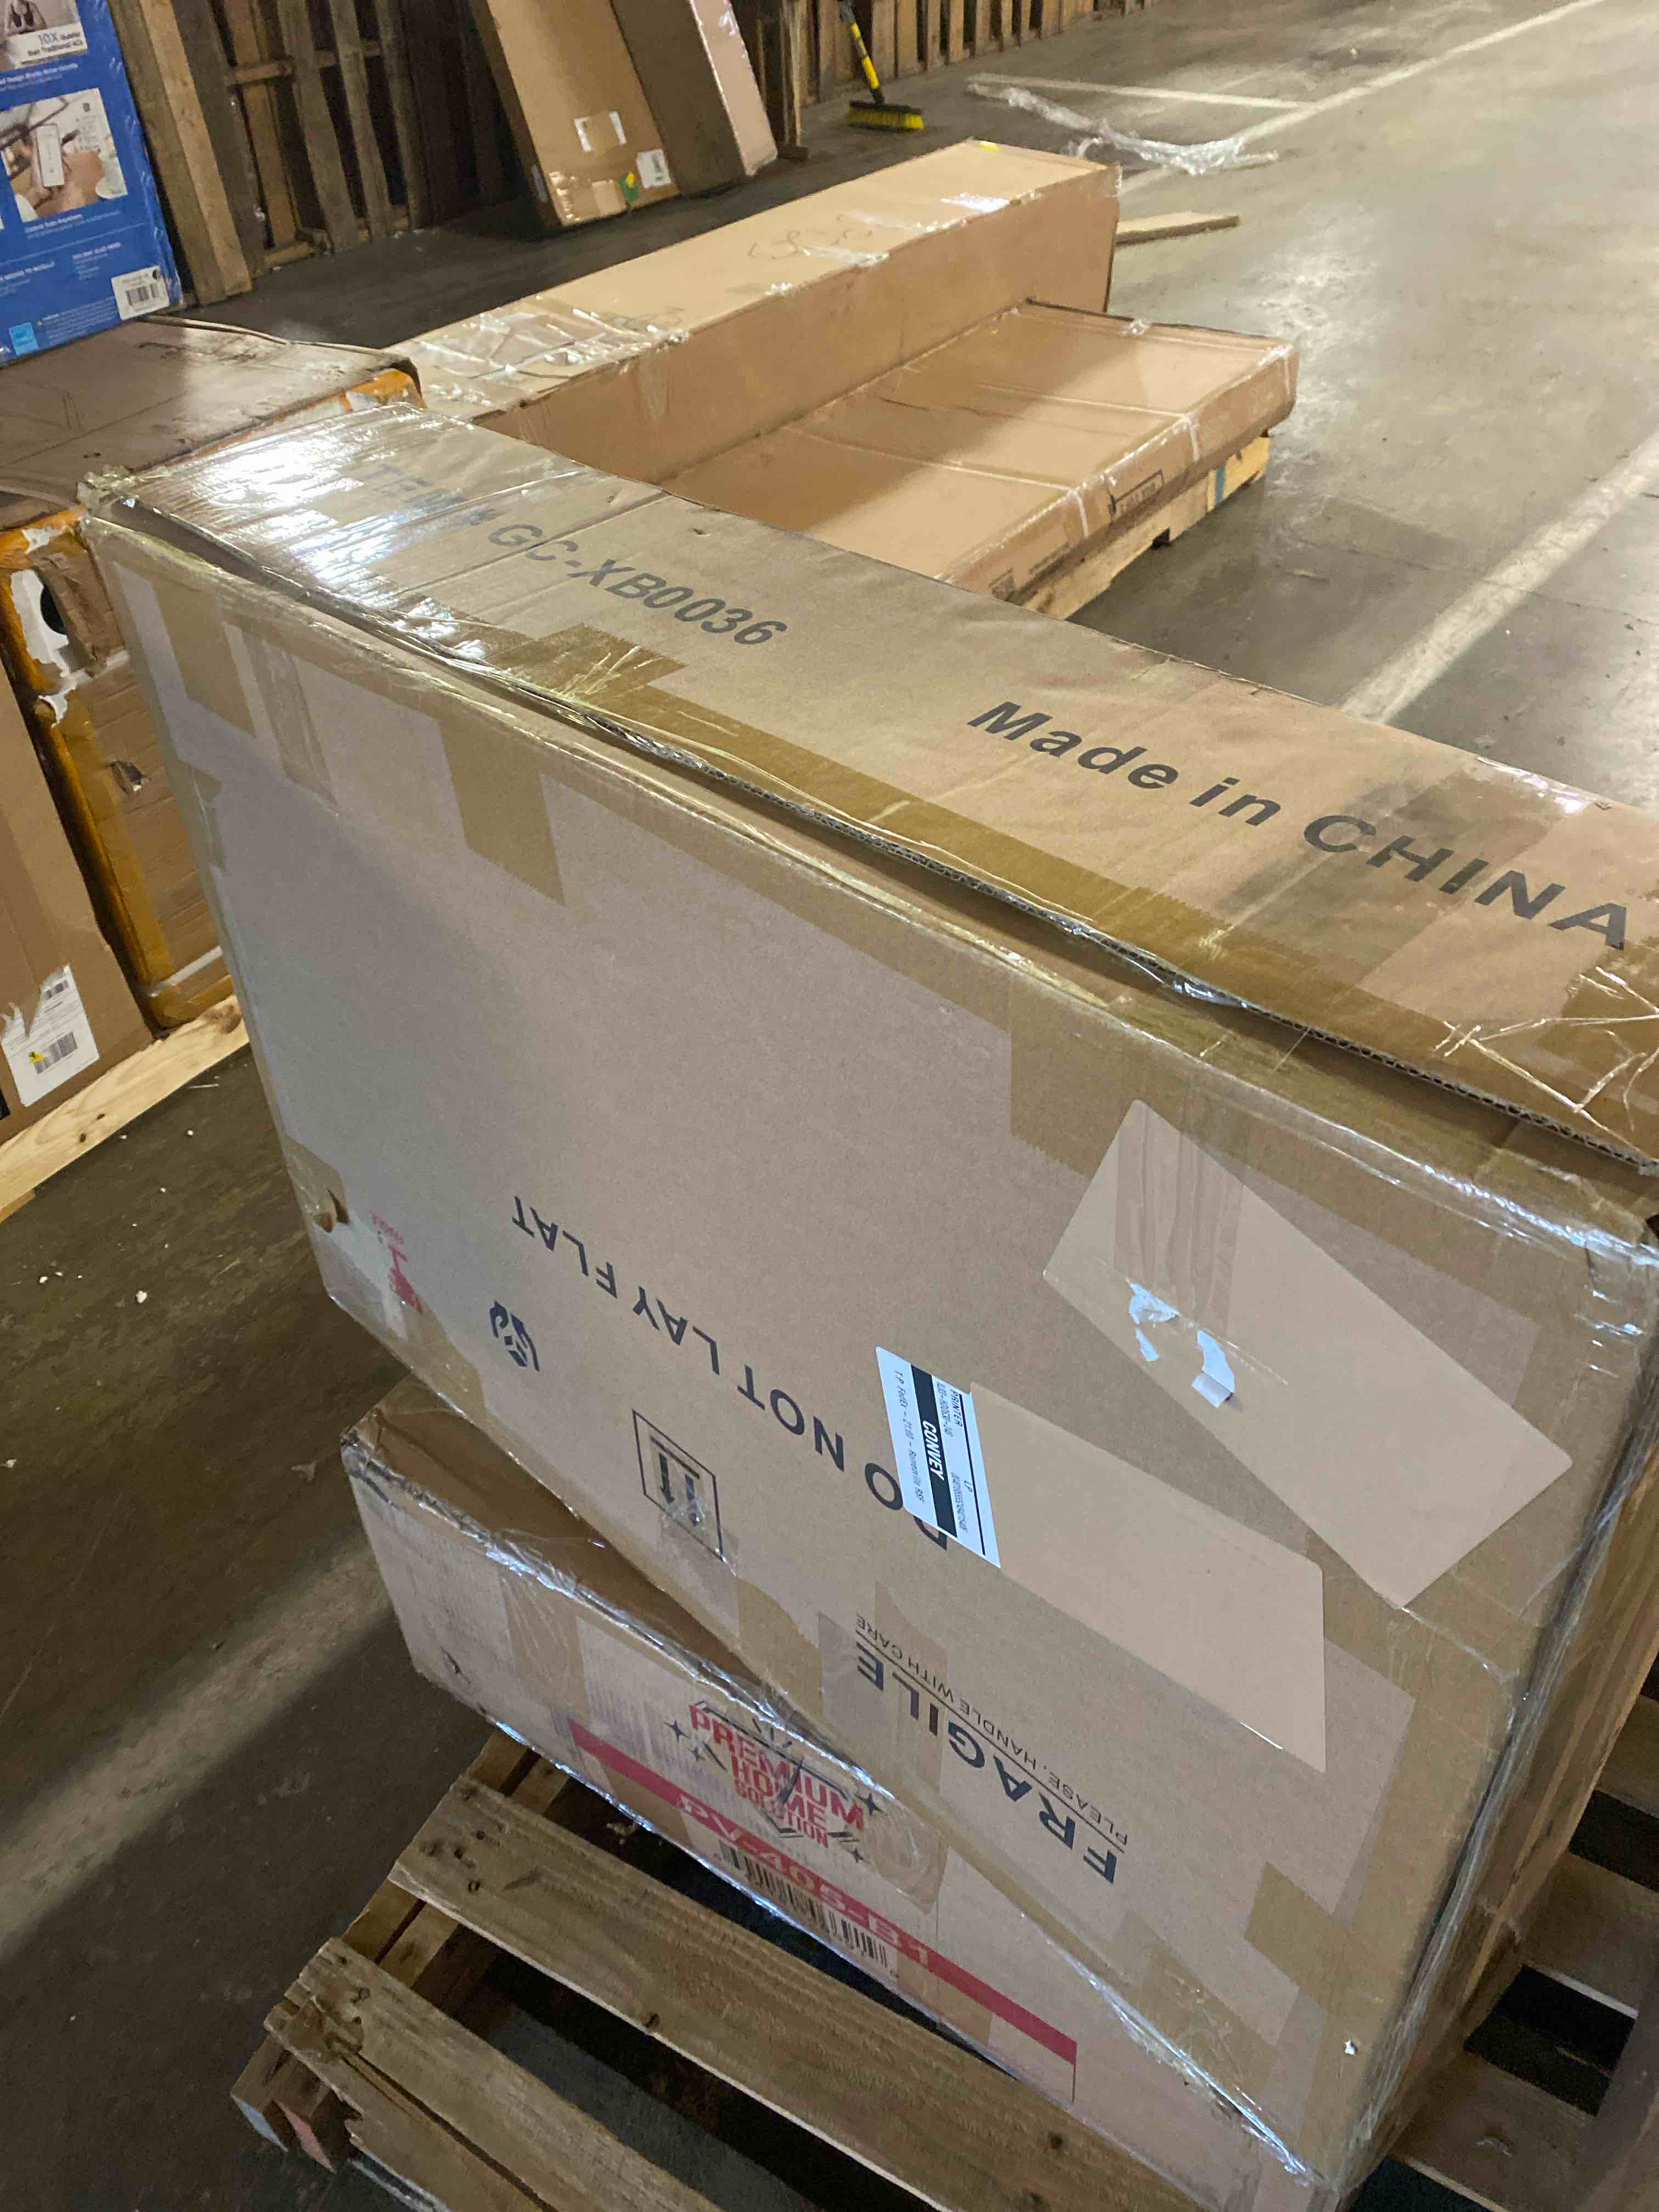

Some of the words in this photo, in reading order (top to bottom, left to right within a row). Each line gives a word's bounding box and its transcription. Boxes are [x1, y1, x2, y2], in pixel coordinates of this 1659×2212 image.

[488, 523, 787, 645] GC-XB0036
[967, 701, 1178, 789] Made
[1190, 777, 1282, 826] in
[1304, 815, 1628, 952] CHINA
[511, 1196, 618, 1299] FLAT
[632, 1286, 720, 1375] LAY
[737, 1364, 845, 1472] NOT
[922, 1420, 945, 1481] CONVEY
[856, 1613, 903, 1659] CARE
[909, 1657, 953, 1703] WITH
[689, 1703, 865, 1832] PREMIUM
[856, 1641, 1118, 1884] FRAGILE
[960, 1699, 1036, 1770] HANDLE
[731, 1754, 827, 1829] HOME
